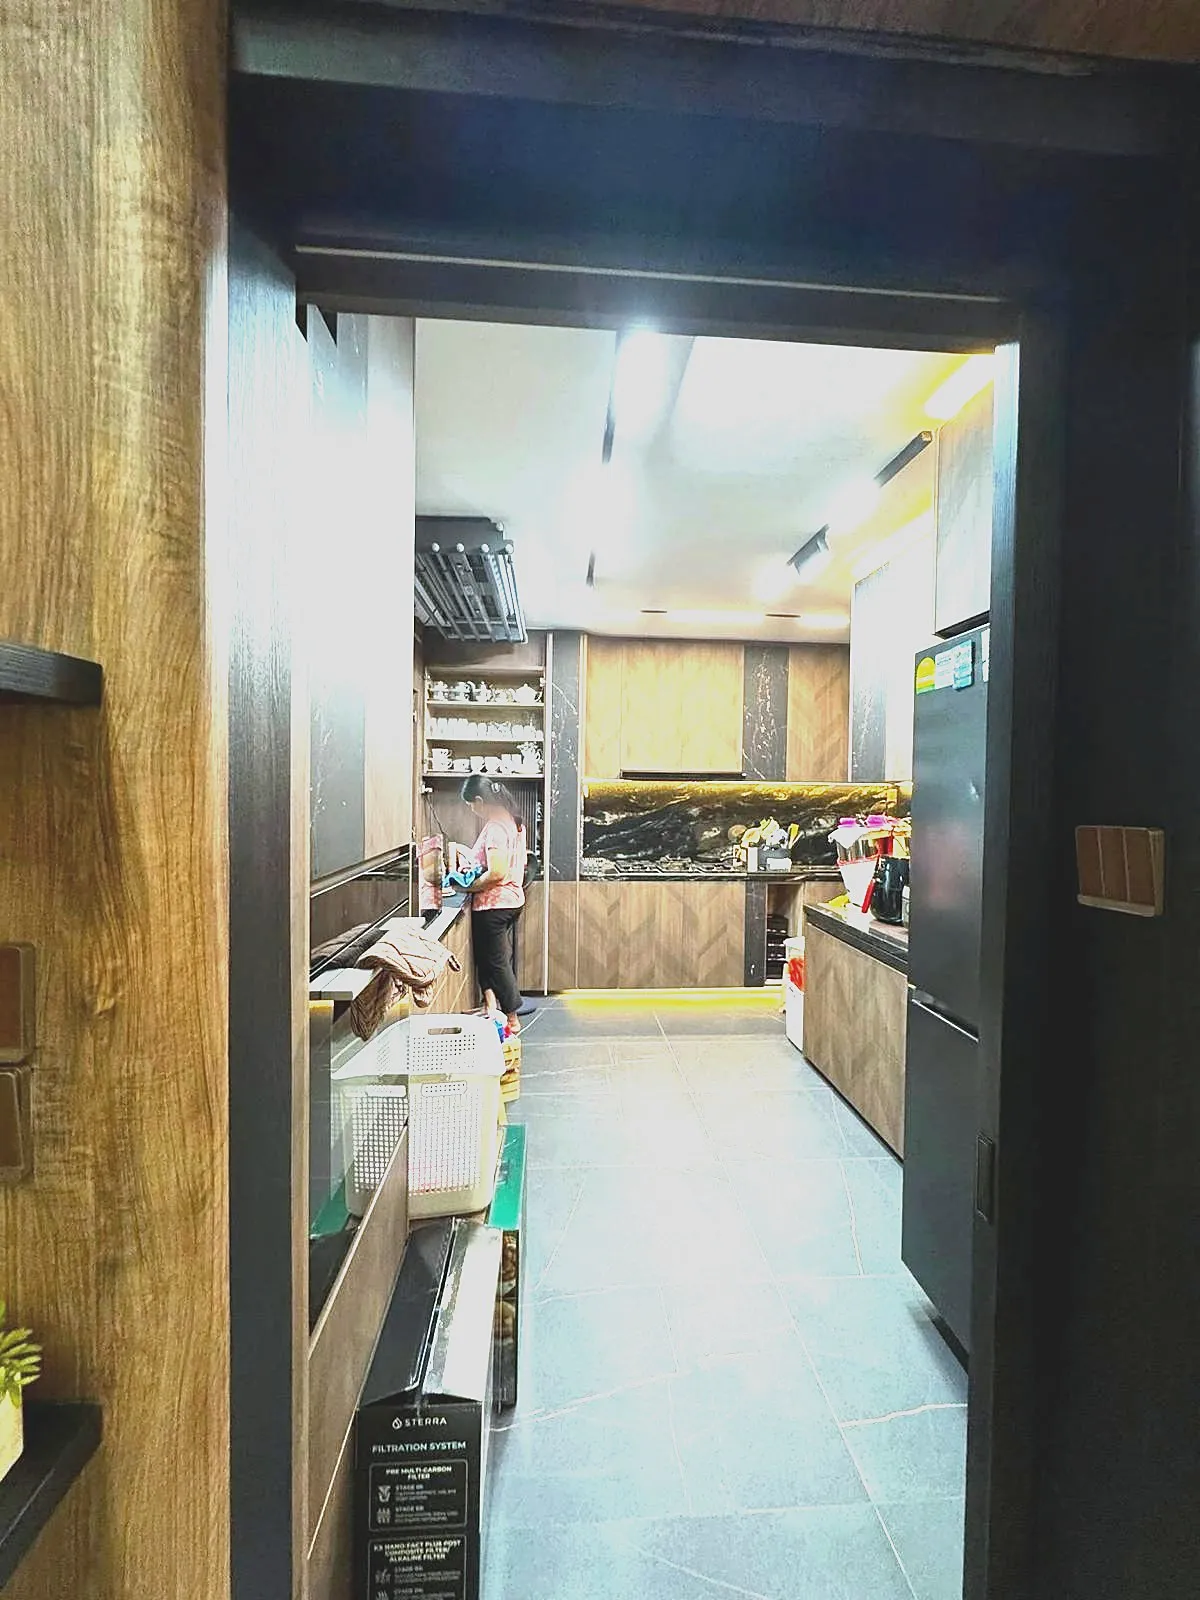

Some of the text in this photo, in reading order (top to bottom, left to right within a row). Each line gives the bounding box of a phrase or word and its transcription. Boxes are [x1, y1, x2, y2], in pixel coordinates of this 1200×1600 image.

[405, 1417, 447, 1427] STERRA
[372, 1441, 466, 1453] FILTRATION SYSTEM
